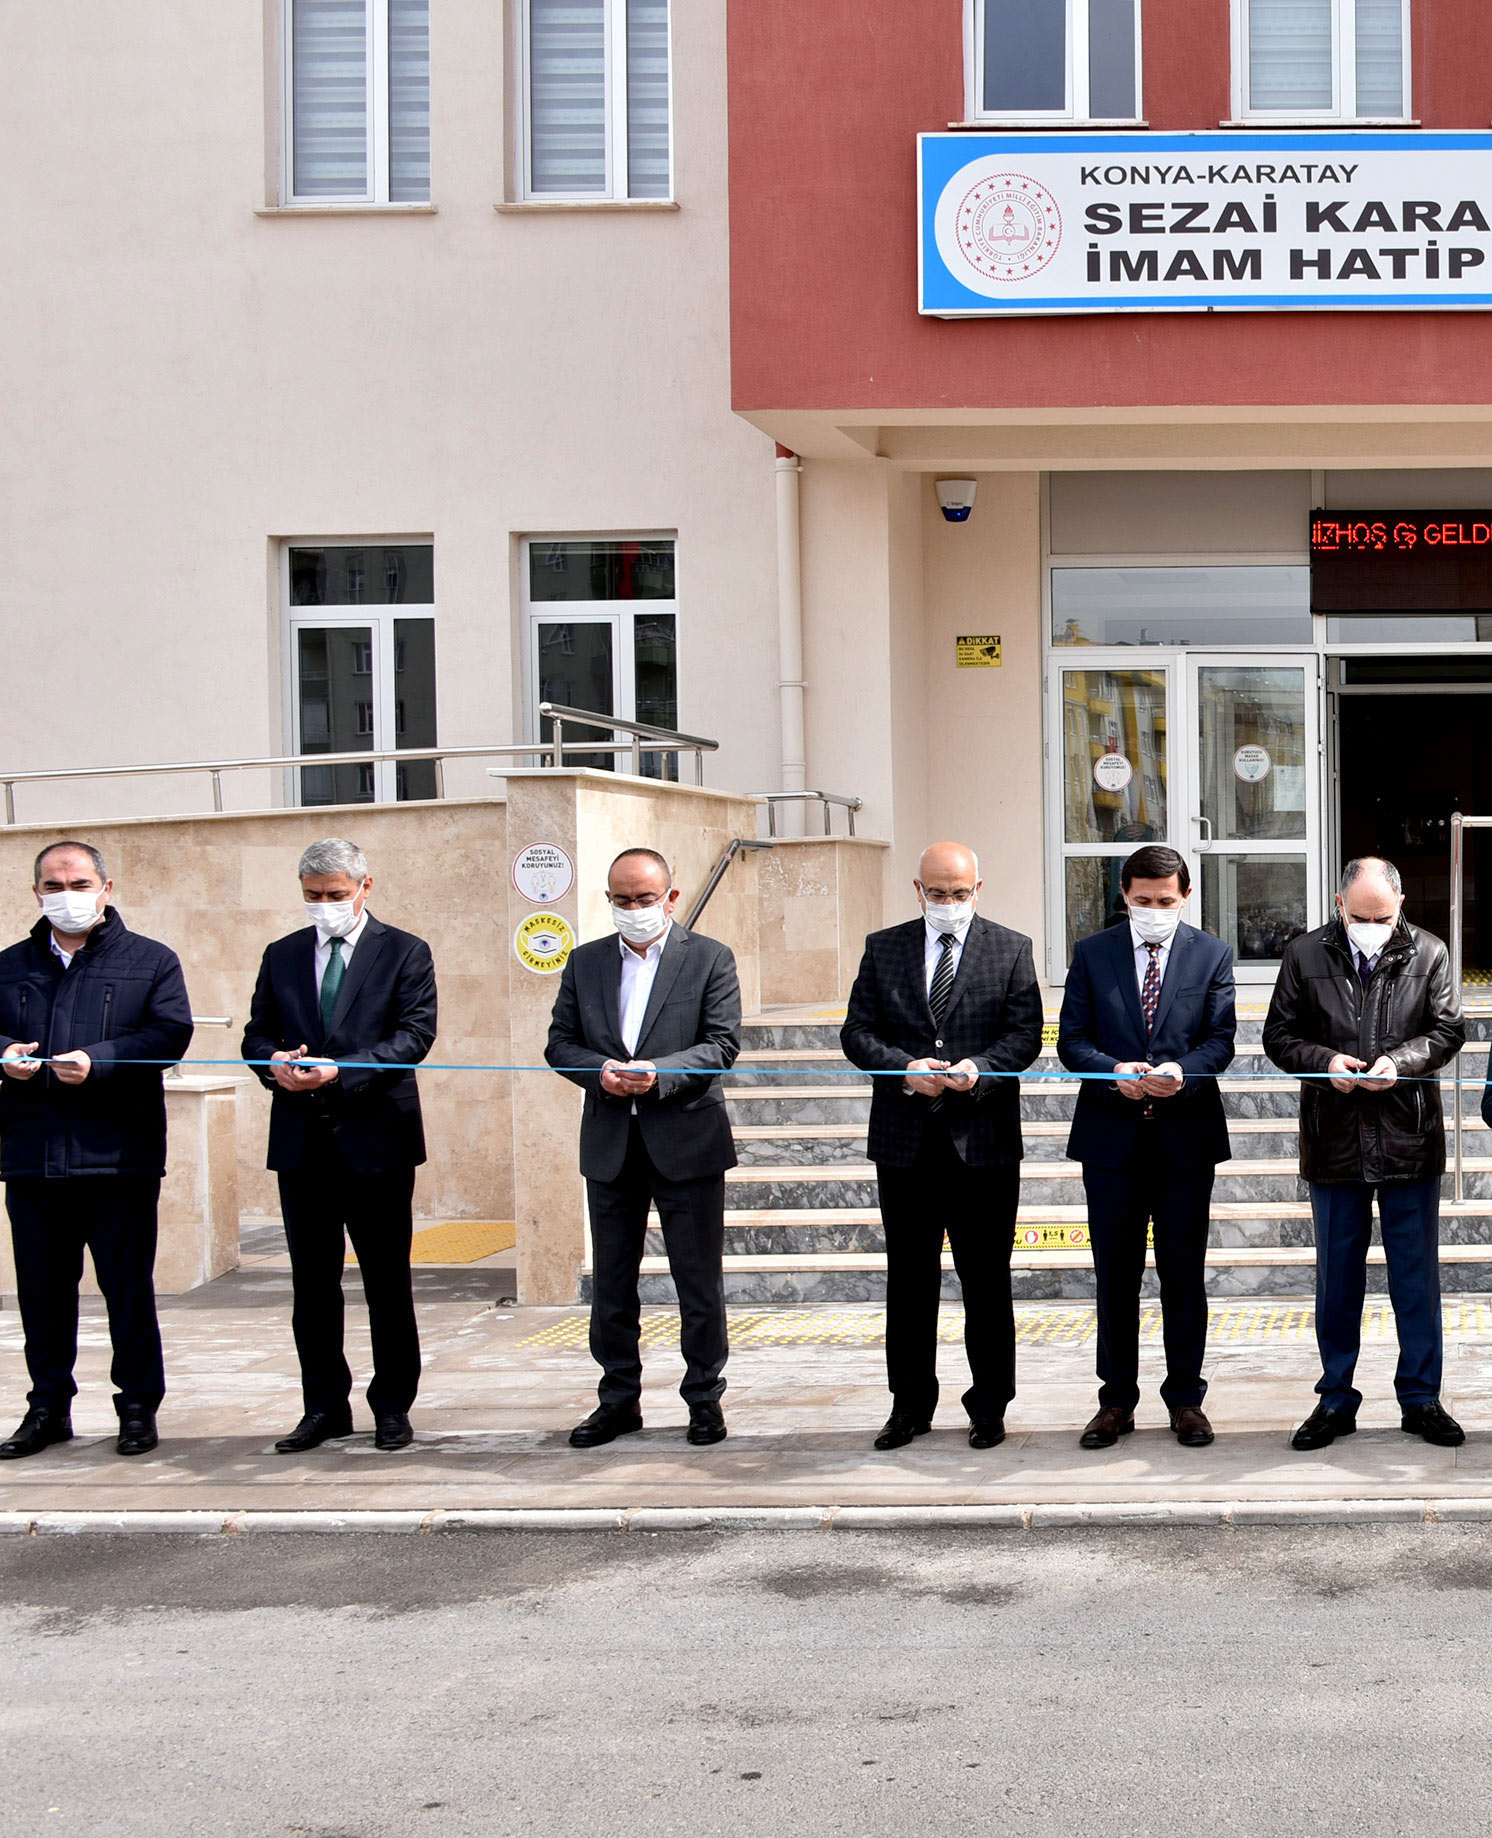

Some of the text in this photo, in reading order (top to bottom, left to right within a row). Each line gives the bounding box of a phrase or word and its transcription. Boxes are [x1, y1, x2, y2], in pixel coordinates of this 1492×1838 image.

[1081, 165, 1358, 185] KONYA-KARATAY
[1084, 192, 1277, 235] SEZAİ
[1087, 241, 1261, 282] İMAM
[1290, 239, 1484, 280] HATİP
[966, 636, 999, 645] DİKKAT
[524, 917, 566, 932] MASKESİZ
[522, 950, 568, 968] GİRMEYİNİZ
